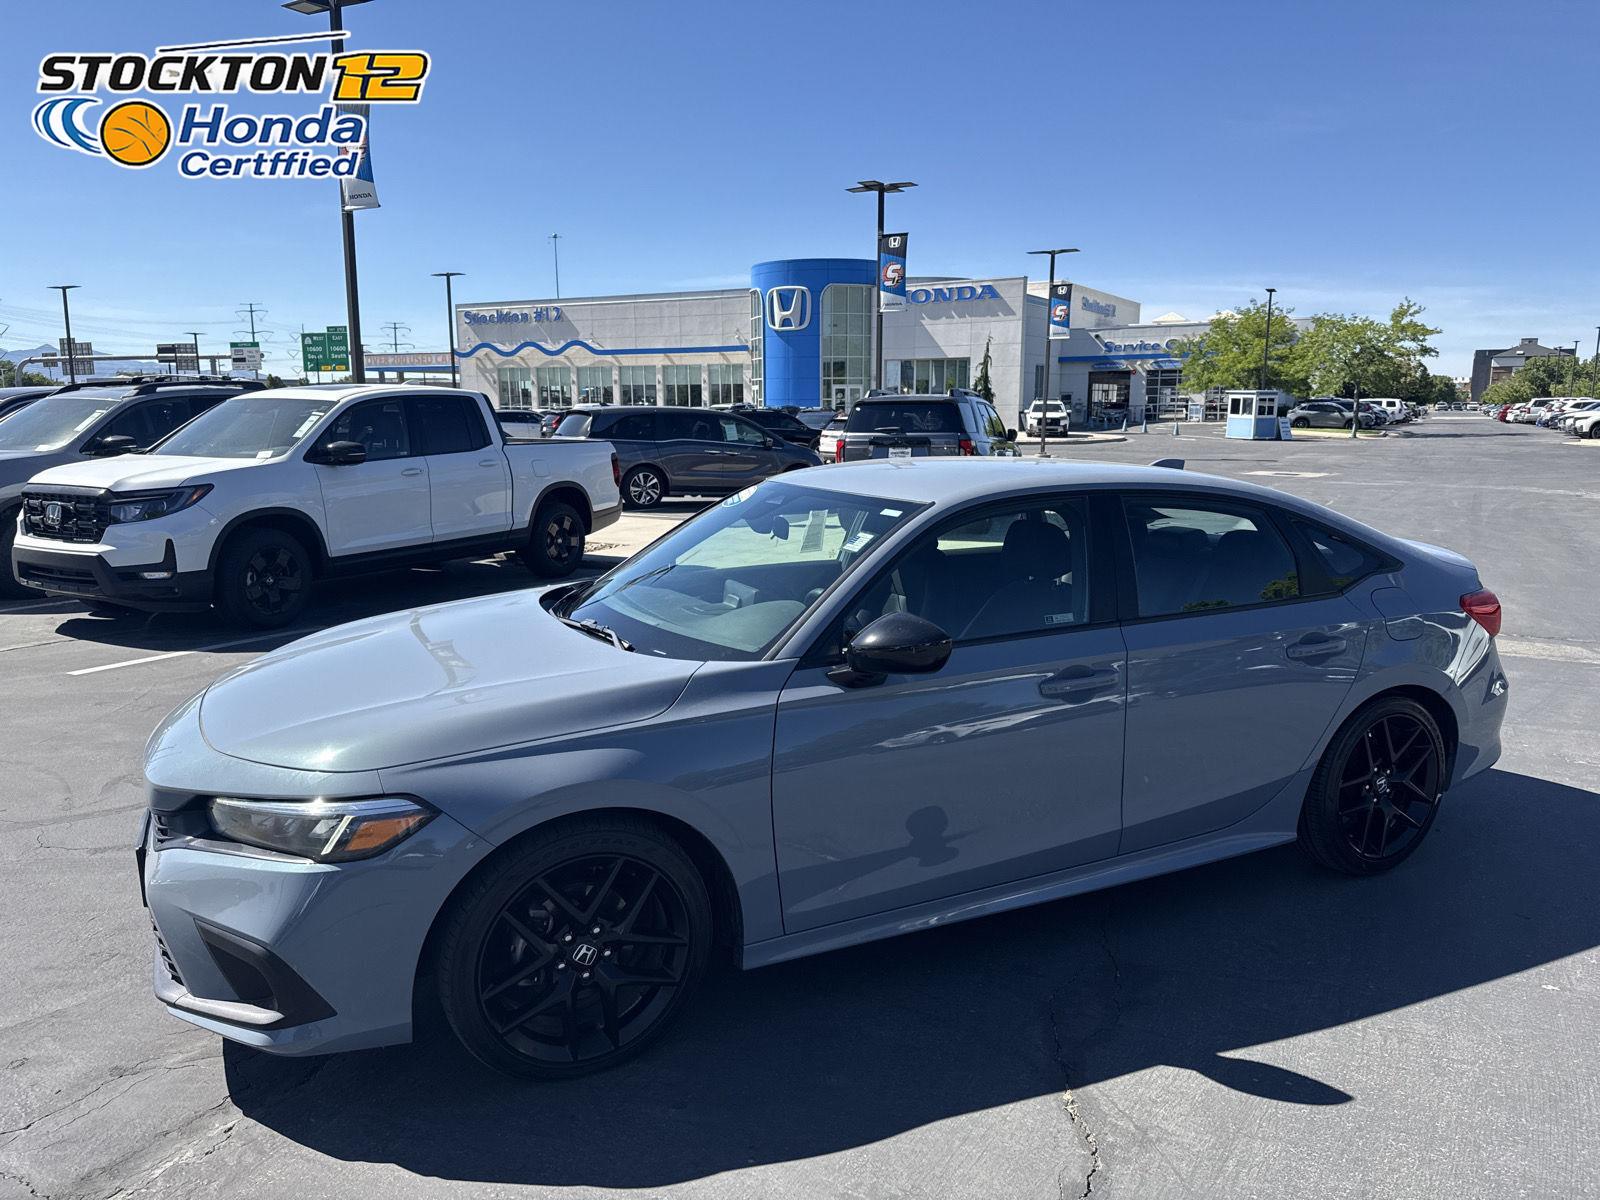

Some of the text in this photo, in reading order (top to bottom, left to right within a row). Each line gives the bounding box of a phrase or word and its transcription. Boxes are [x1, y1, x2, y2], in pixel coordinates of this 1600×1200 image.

[349, 192, 373, 200] HONDA
[906, 284, 1001, 304] ONDA
[464, 310, 529, 324] Stockton
[1104, 340, 1161, 353] Service
